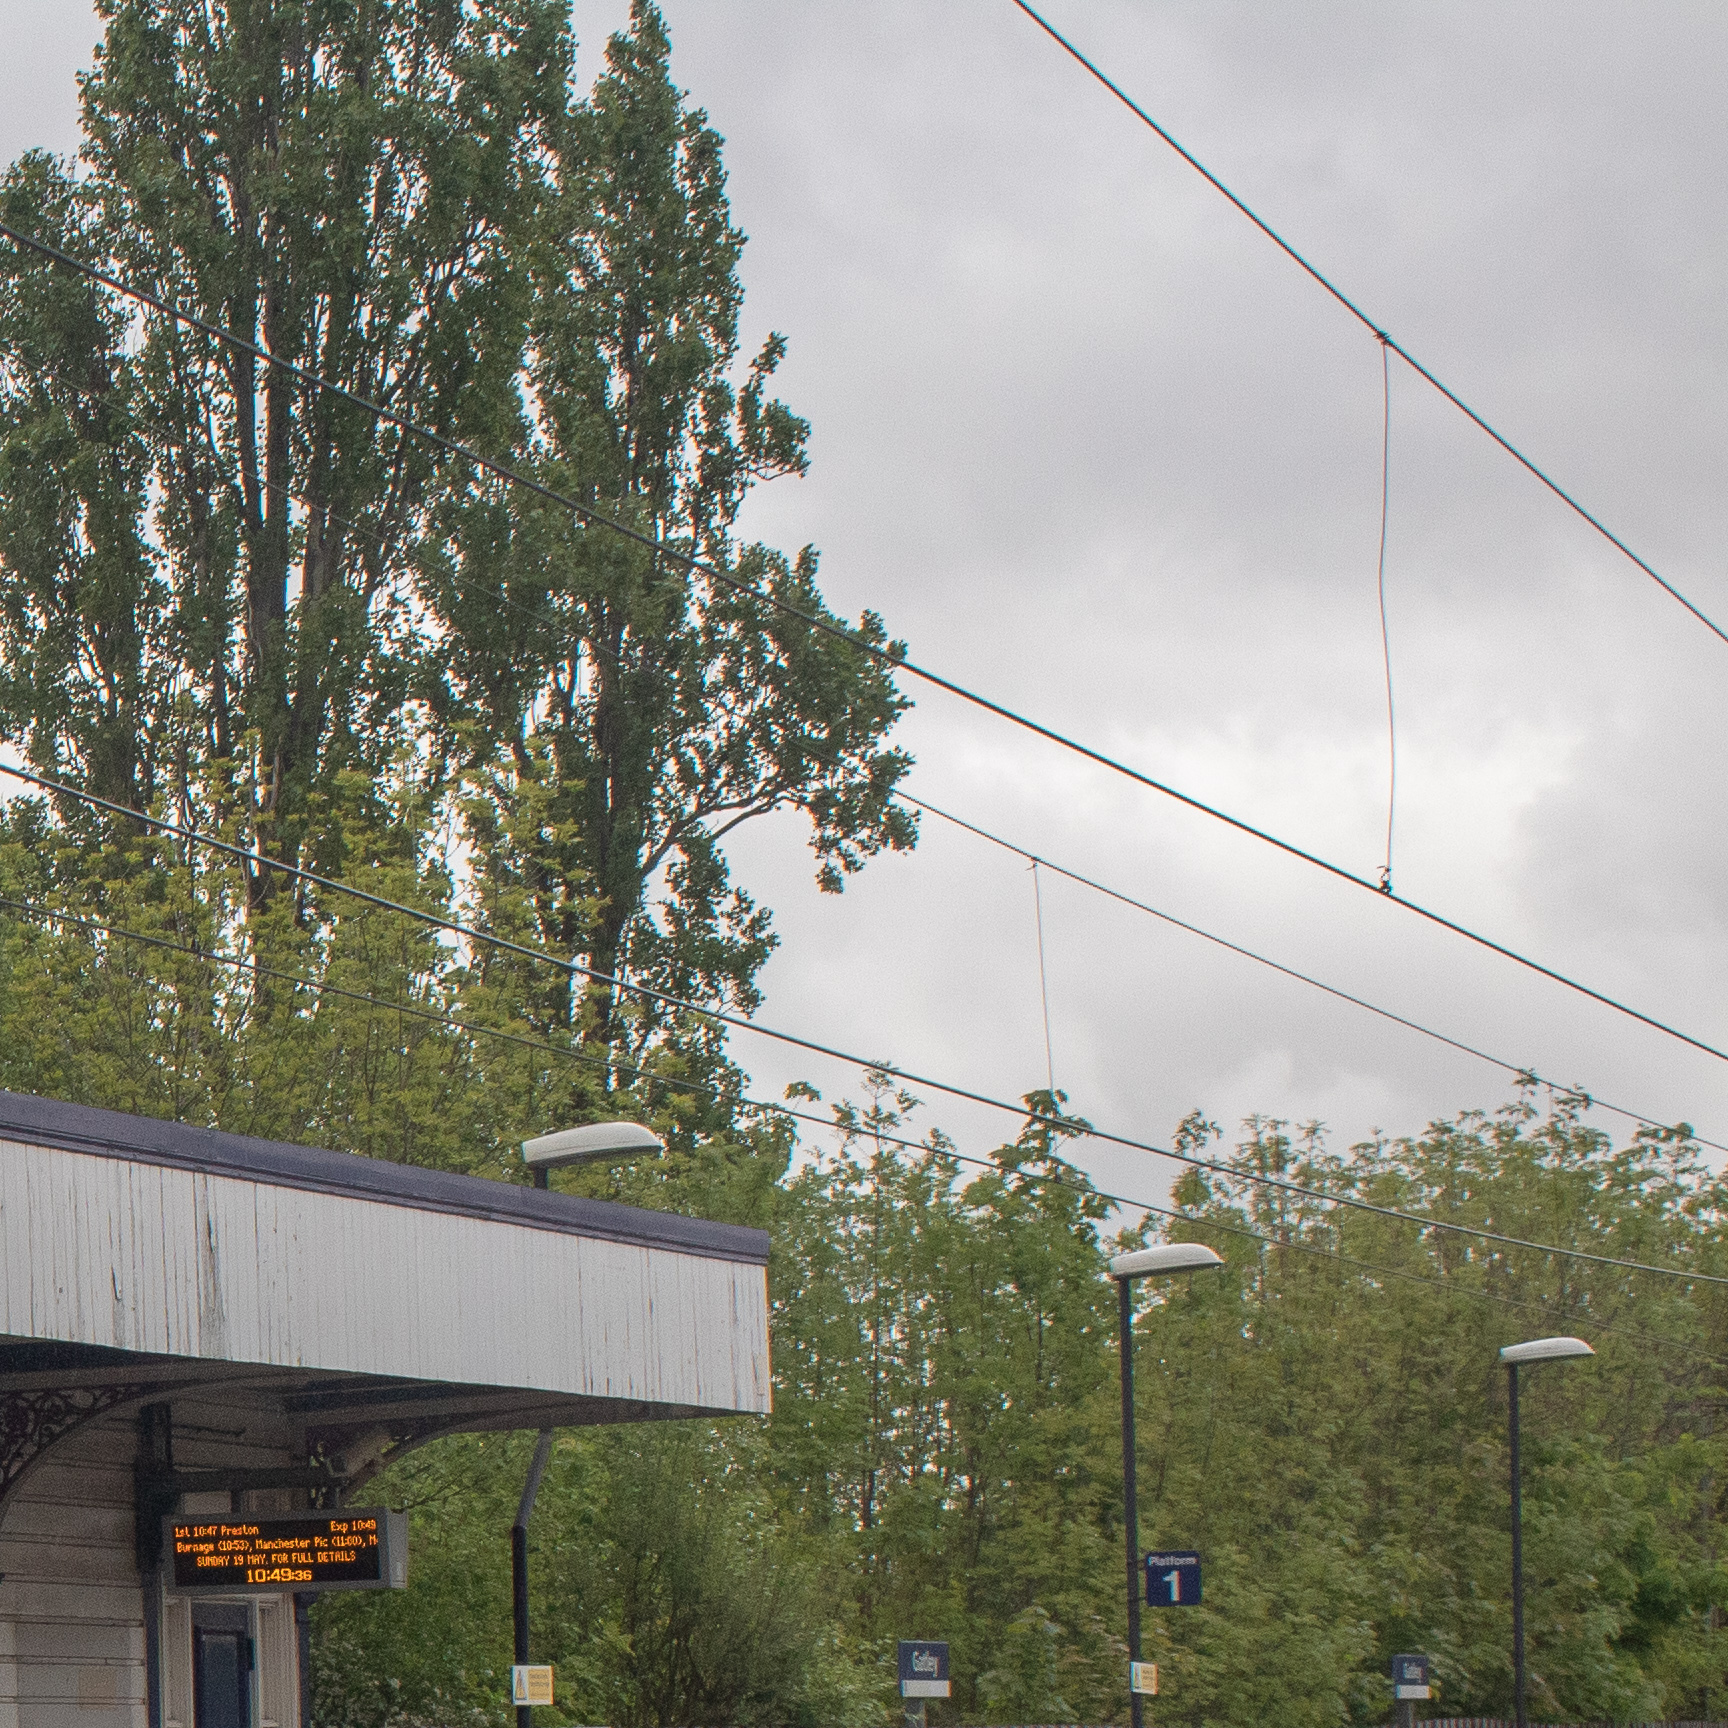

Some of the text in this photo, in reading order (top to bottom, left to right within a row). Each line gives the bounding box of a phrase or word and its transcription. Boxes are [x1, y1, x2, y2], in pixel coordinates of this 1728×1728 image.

[175, 1524, 260, 1538] 1st 10:47 Preston
[330, 1519, 377, 1534] Exp 10:49
[176, 1541, 215, 1554] Burnage
[218, 1540, 253, 1553] (10:53),
[255, 1537, 311, 1550] Manchester
[314, 1536, 329, 1548] Pic
[331, 1535, 366, 1549] (11:00),
[197, 1555, 230, 1567] SUNDAY
[233, 1554, 244, 1566] 19
[271, 1553, 289, 1564] FOR
[291, 1552, 314, 1563] FULL
[317, 1550, 356, 1562] DETAILS
[1148, 1556, 1197, 1566] Platform
[247, 1568, 312, 1583] 10:49:36
[1163, 1570, 1180, 1601] 1
